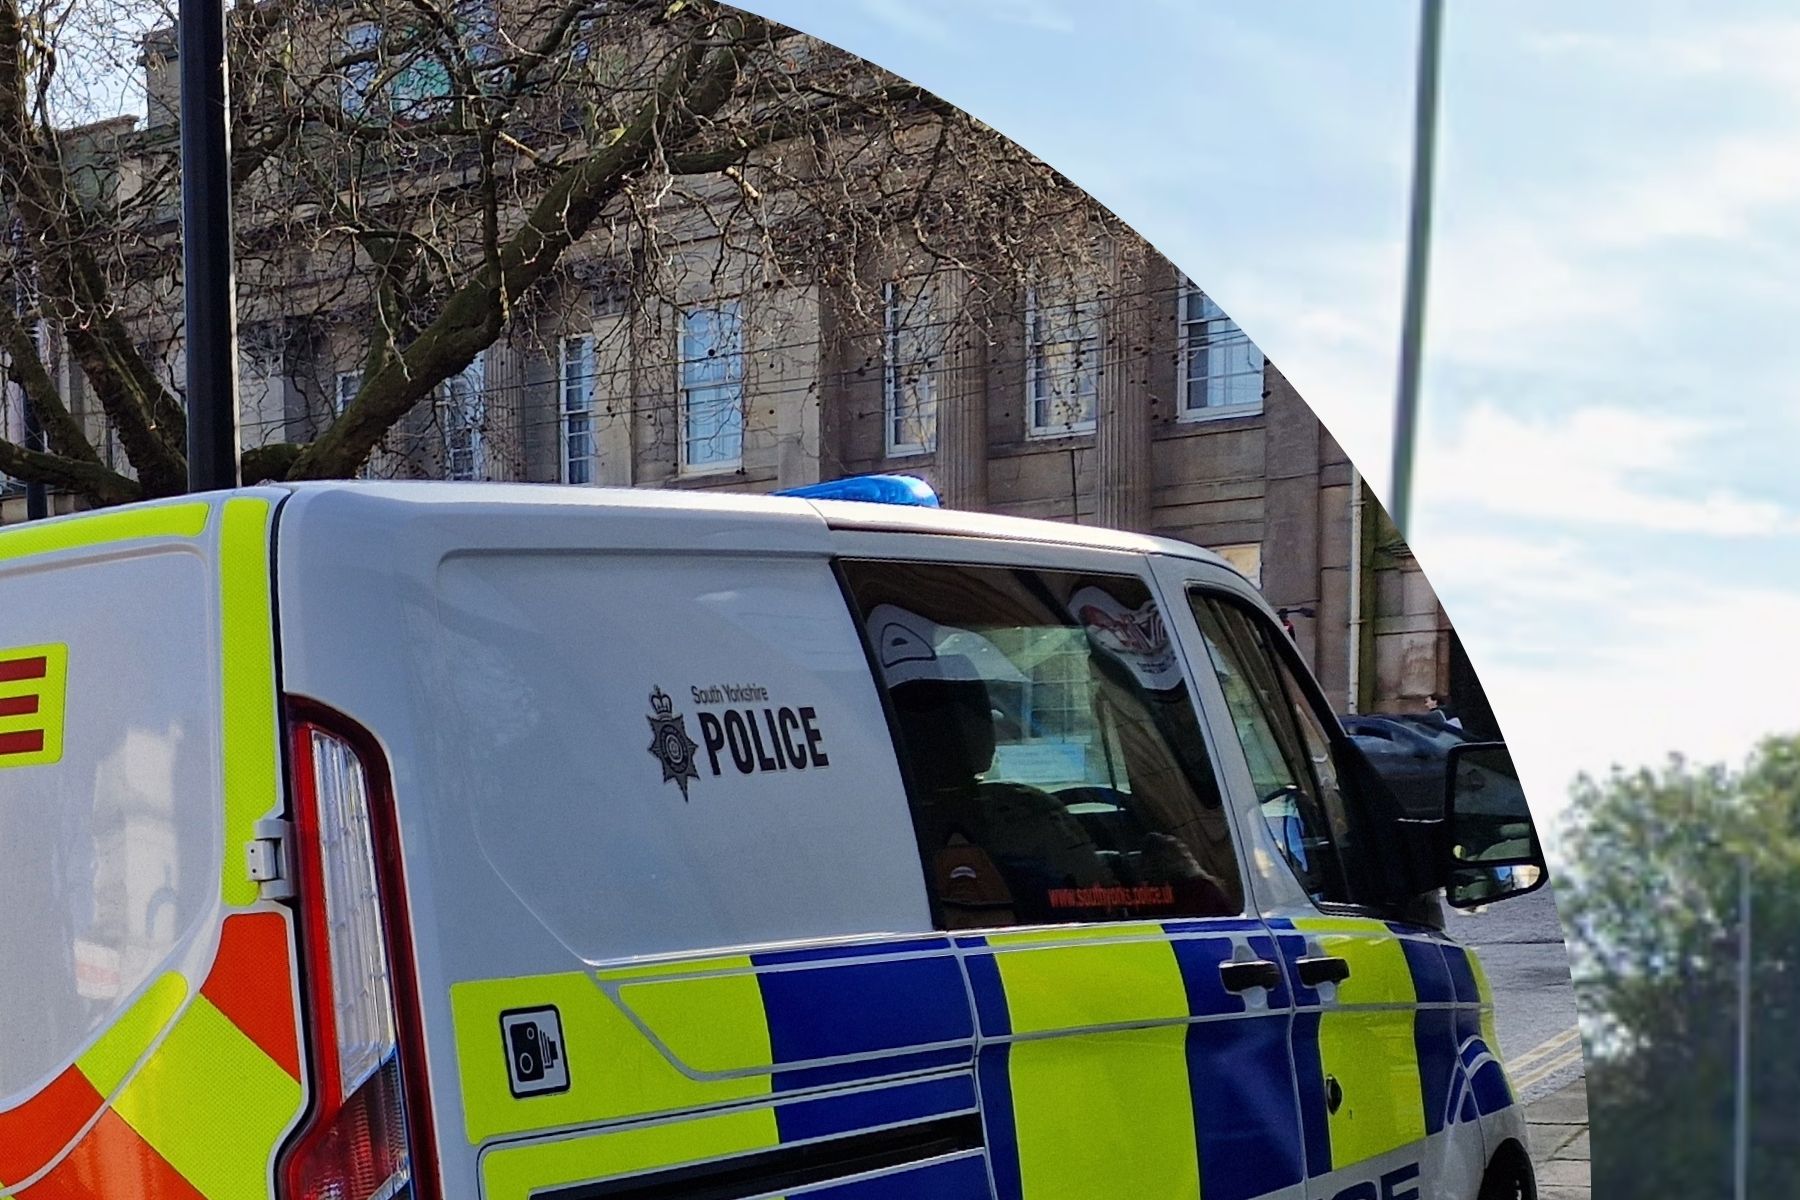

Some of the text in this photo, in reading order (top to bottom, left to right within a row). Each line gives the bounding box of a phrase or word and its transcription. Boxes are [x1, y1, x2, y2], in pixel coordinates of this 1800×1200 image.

[692, 683, 769, 704] South Yorkshire
[697, 706, 829, 775] POLICE
